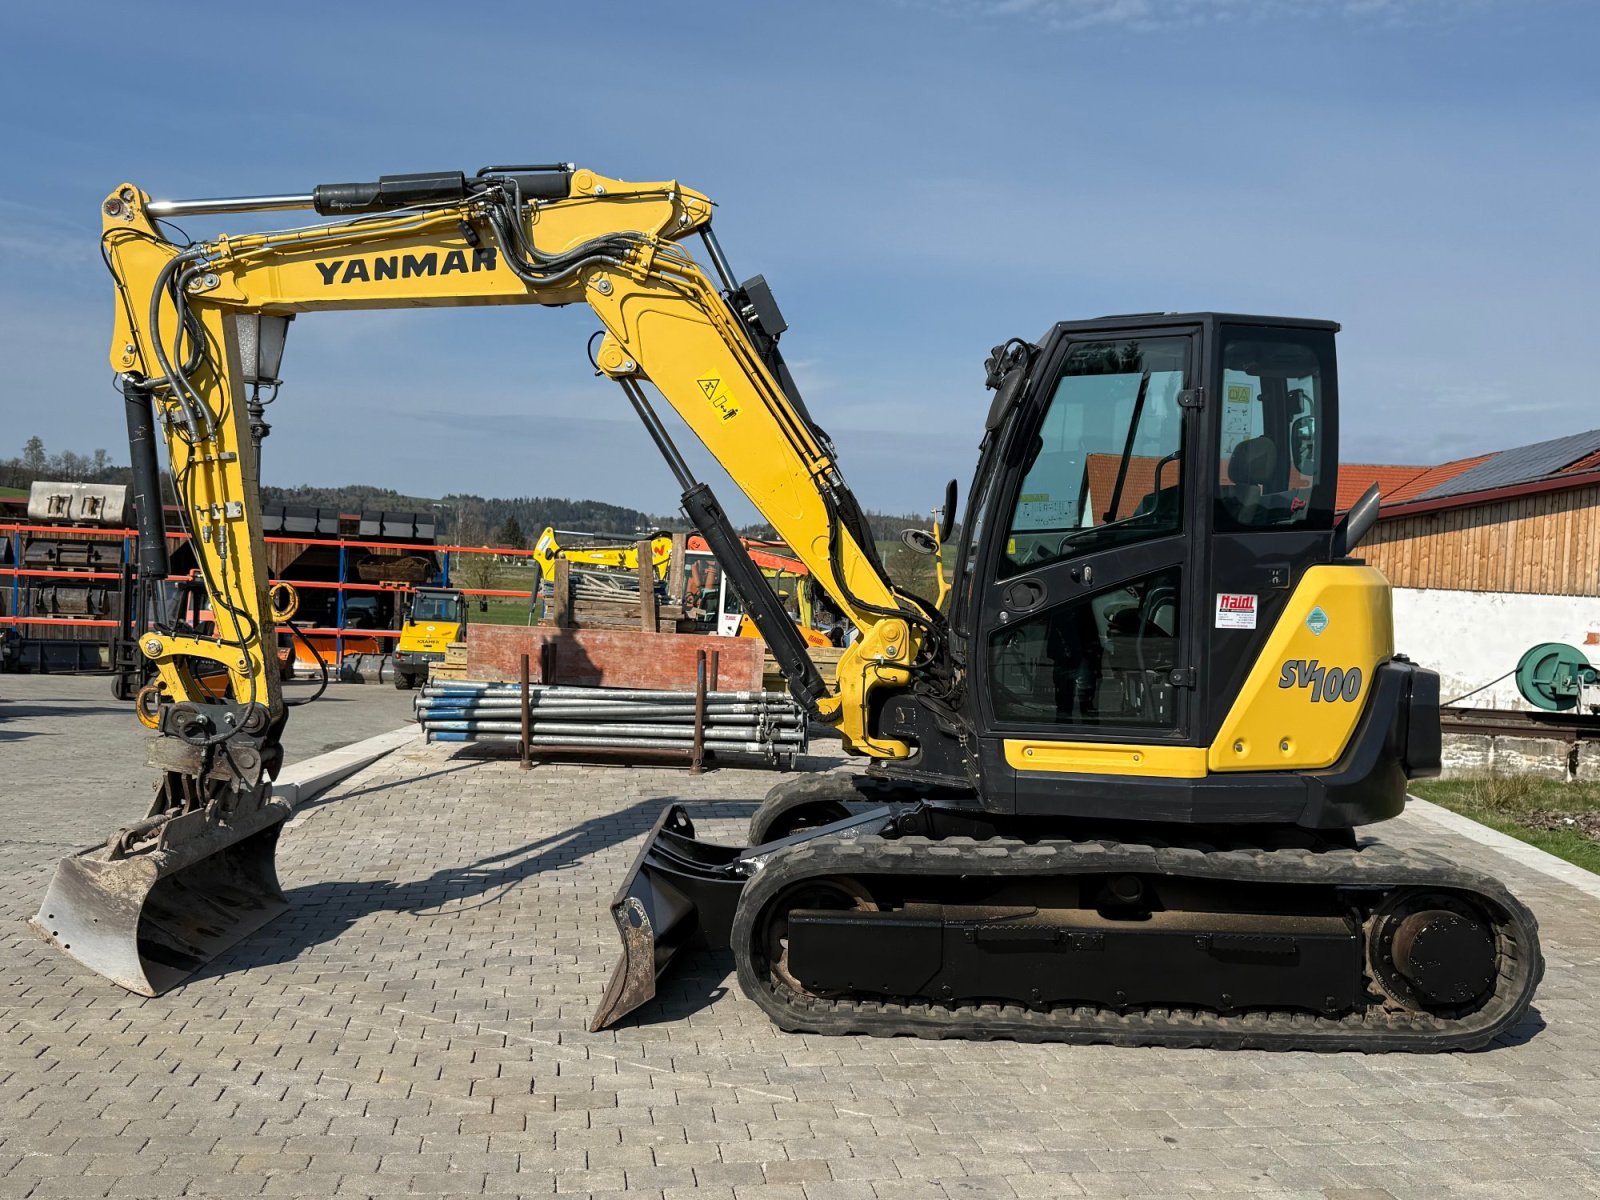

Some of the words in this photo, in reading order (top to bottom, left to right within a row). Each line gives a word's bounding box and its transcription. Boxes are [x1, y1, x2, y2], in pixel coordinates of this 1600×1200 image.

[315, 247, 497, 285] YANMAR
[1220, 595, 1254, 608] Haidl
[1278, 660, 1363, 703] SV100
